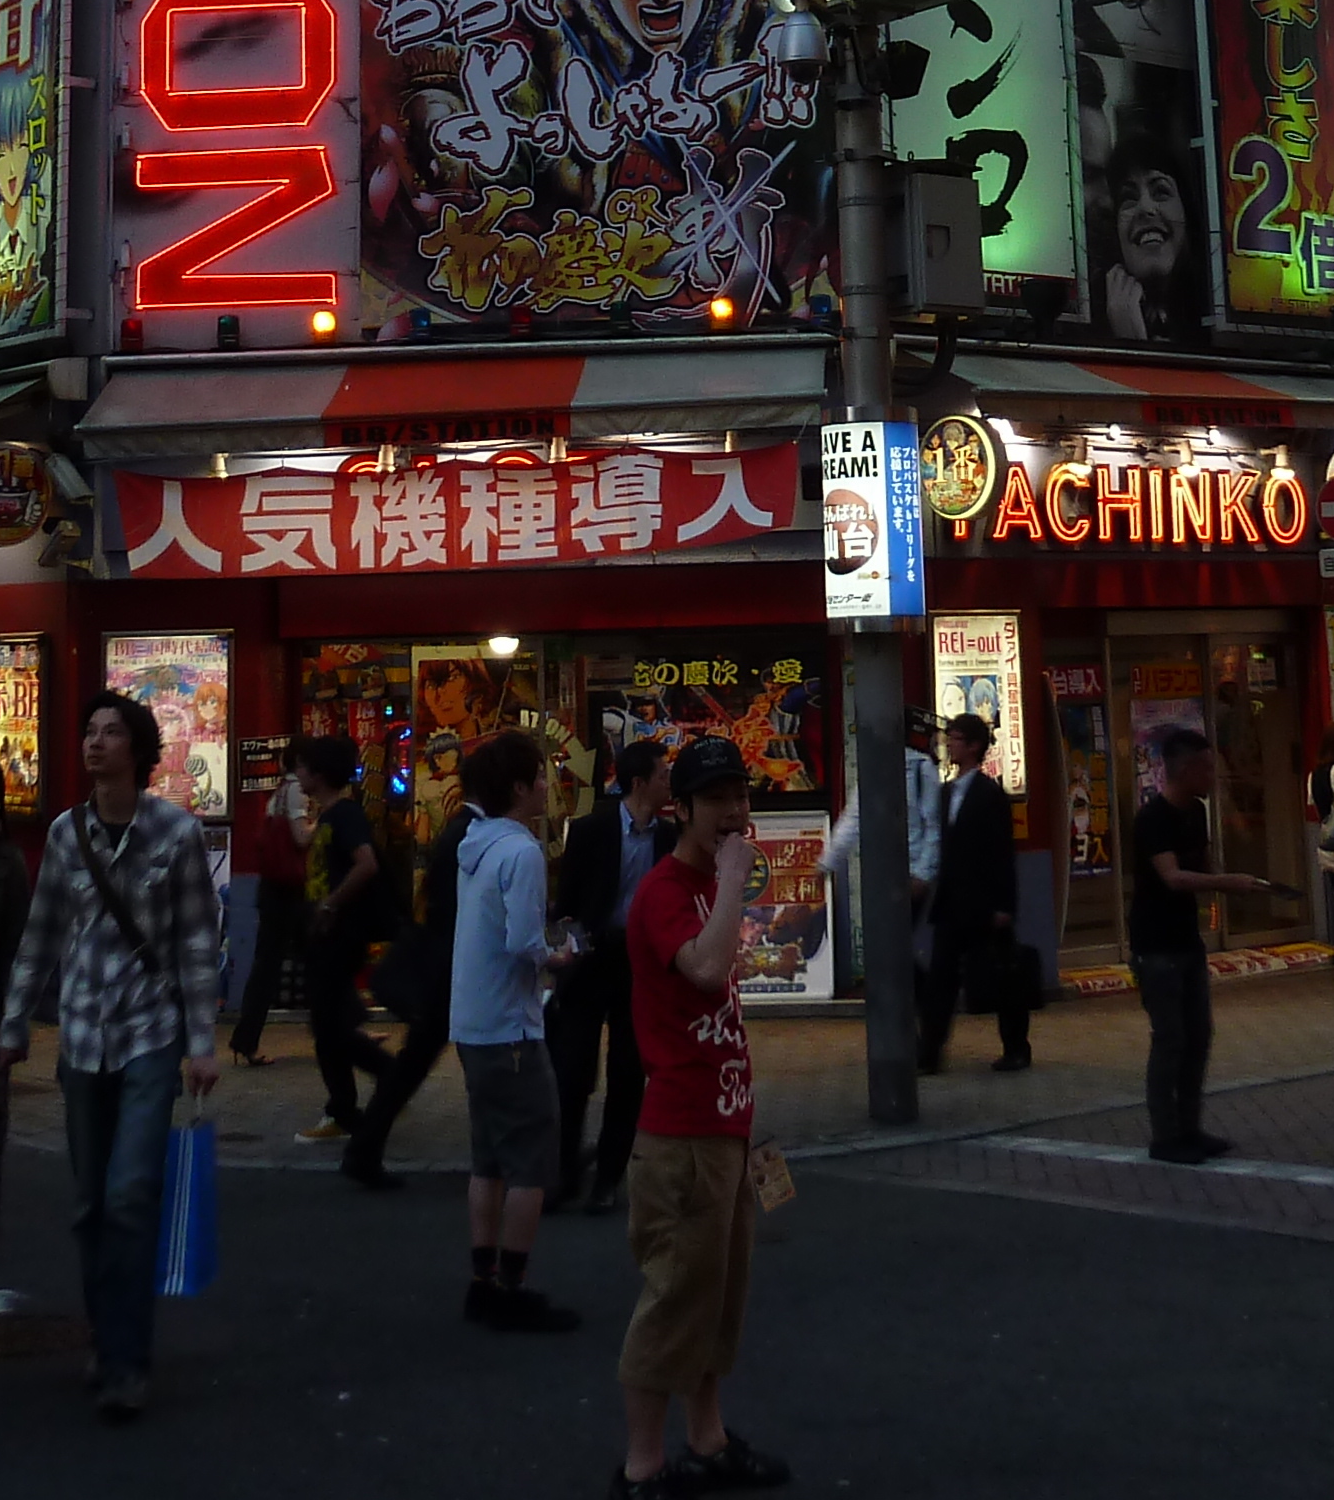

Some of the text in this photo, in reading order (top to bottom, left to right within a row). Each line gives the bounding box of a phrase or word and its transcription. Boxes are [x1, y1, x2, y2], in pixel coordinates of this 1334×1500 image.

[27, 75, 48, 226] スロット
[606, 187, 658, 225] CR
[340, 417, 556, 446] BB/STATION
[861, 430, 876, 452] A
[932, 445, 979, 484] 1番
[128, 453, 774, 574] 人気機種導入
[952, 461, 1308, 547] ACHINKO
[938, 631, 1003, 655] REI=out
